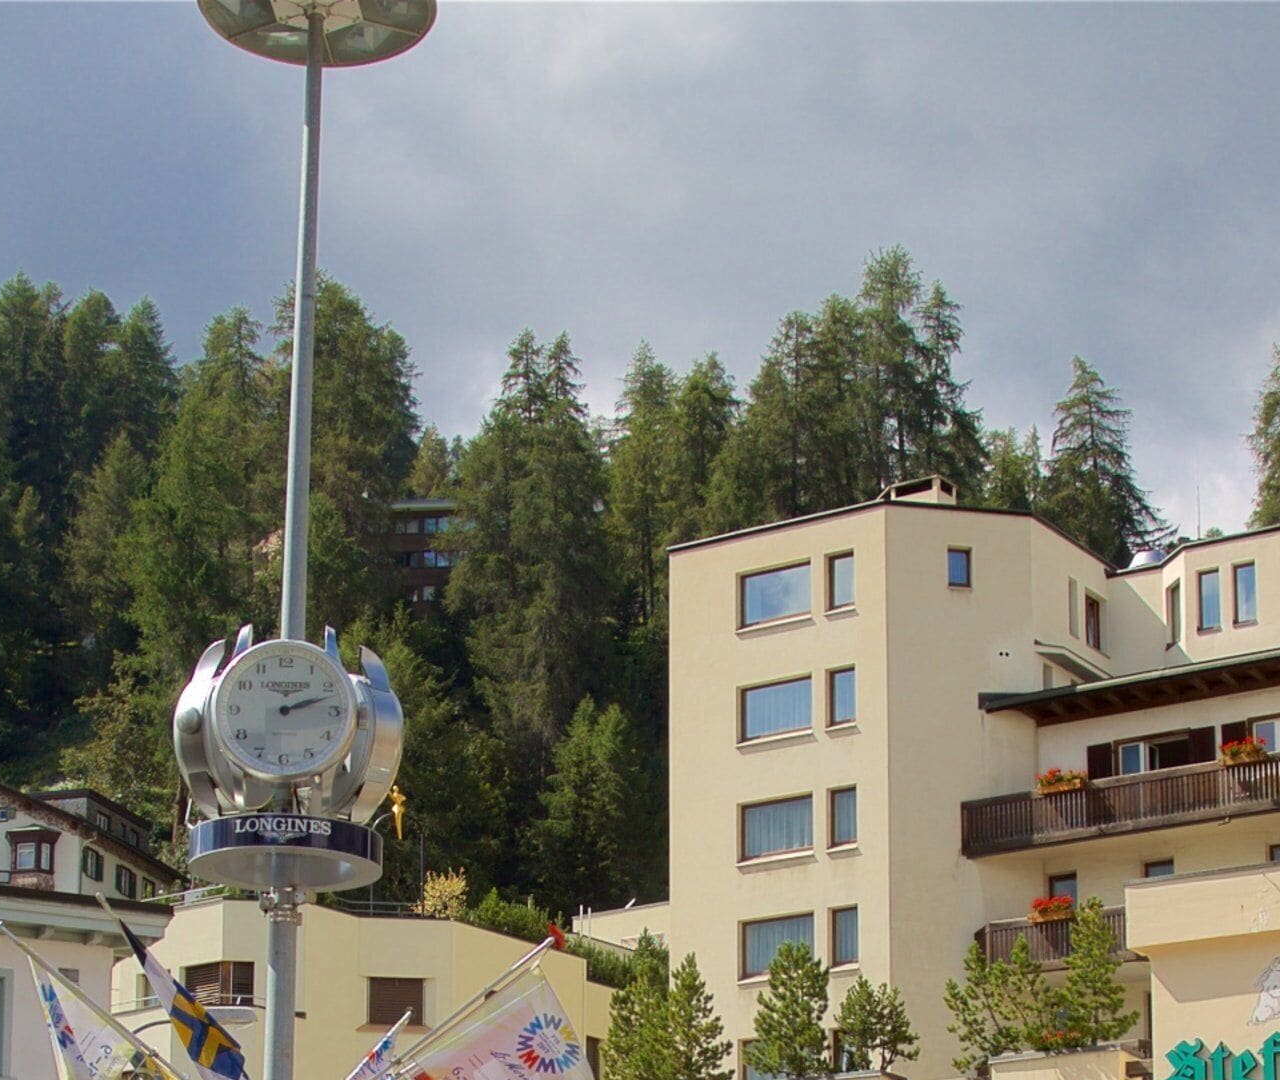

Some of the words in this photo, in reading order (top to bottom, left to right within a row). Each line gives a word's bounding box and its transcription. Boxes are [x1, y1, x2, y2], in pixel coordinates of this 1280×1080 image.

[278, 656, 295, 668] 12
[256, 663, 267, 674] 11
[238, 679, 253, 691] 10
[260, 681, 311, 690] LONGINES
[322, 682, 334, 693] 2
[228, 704, 240, 716] 9
[328, 705, 341, 718] 3
[235, 728, 248, 740] 8
[319, 730, 332, 742] 4
[253, 747, 266, 759] 7
[277, 753, 289, 765] 6
[303, 747, 314, 760] 5
[234, 815, 332, 836] LONGINES
